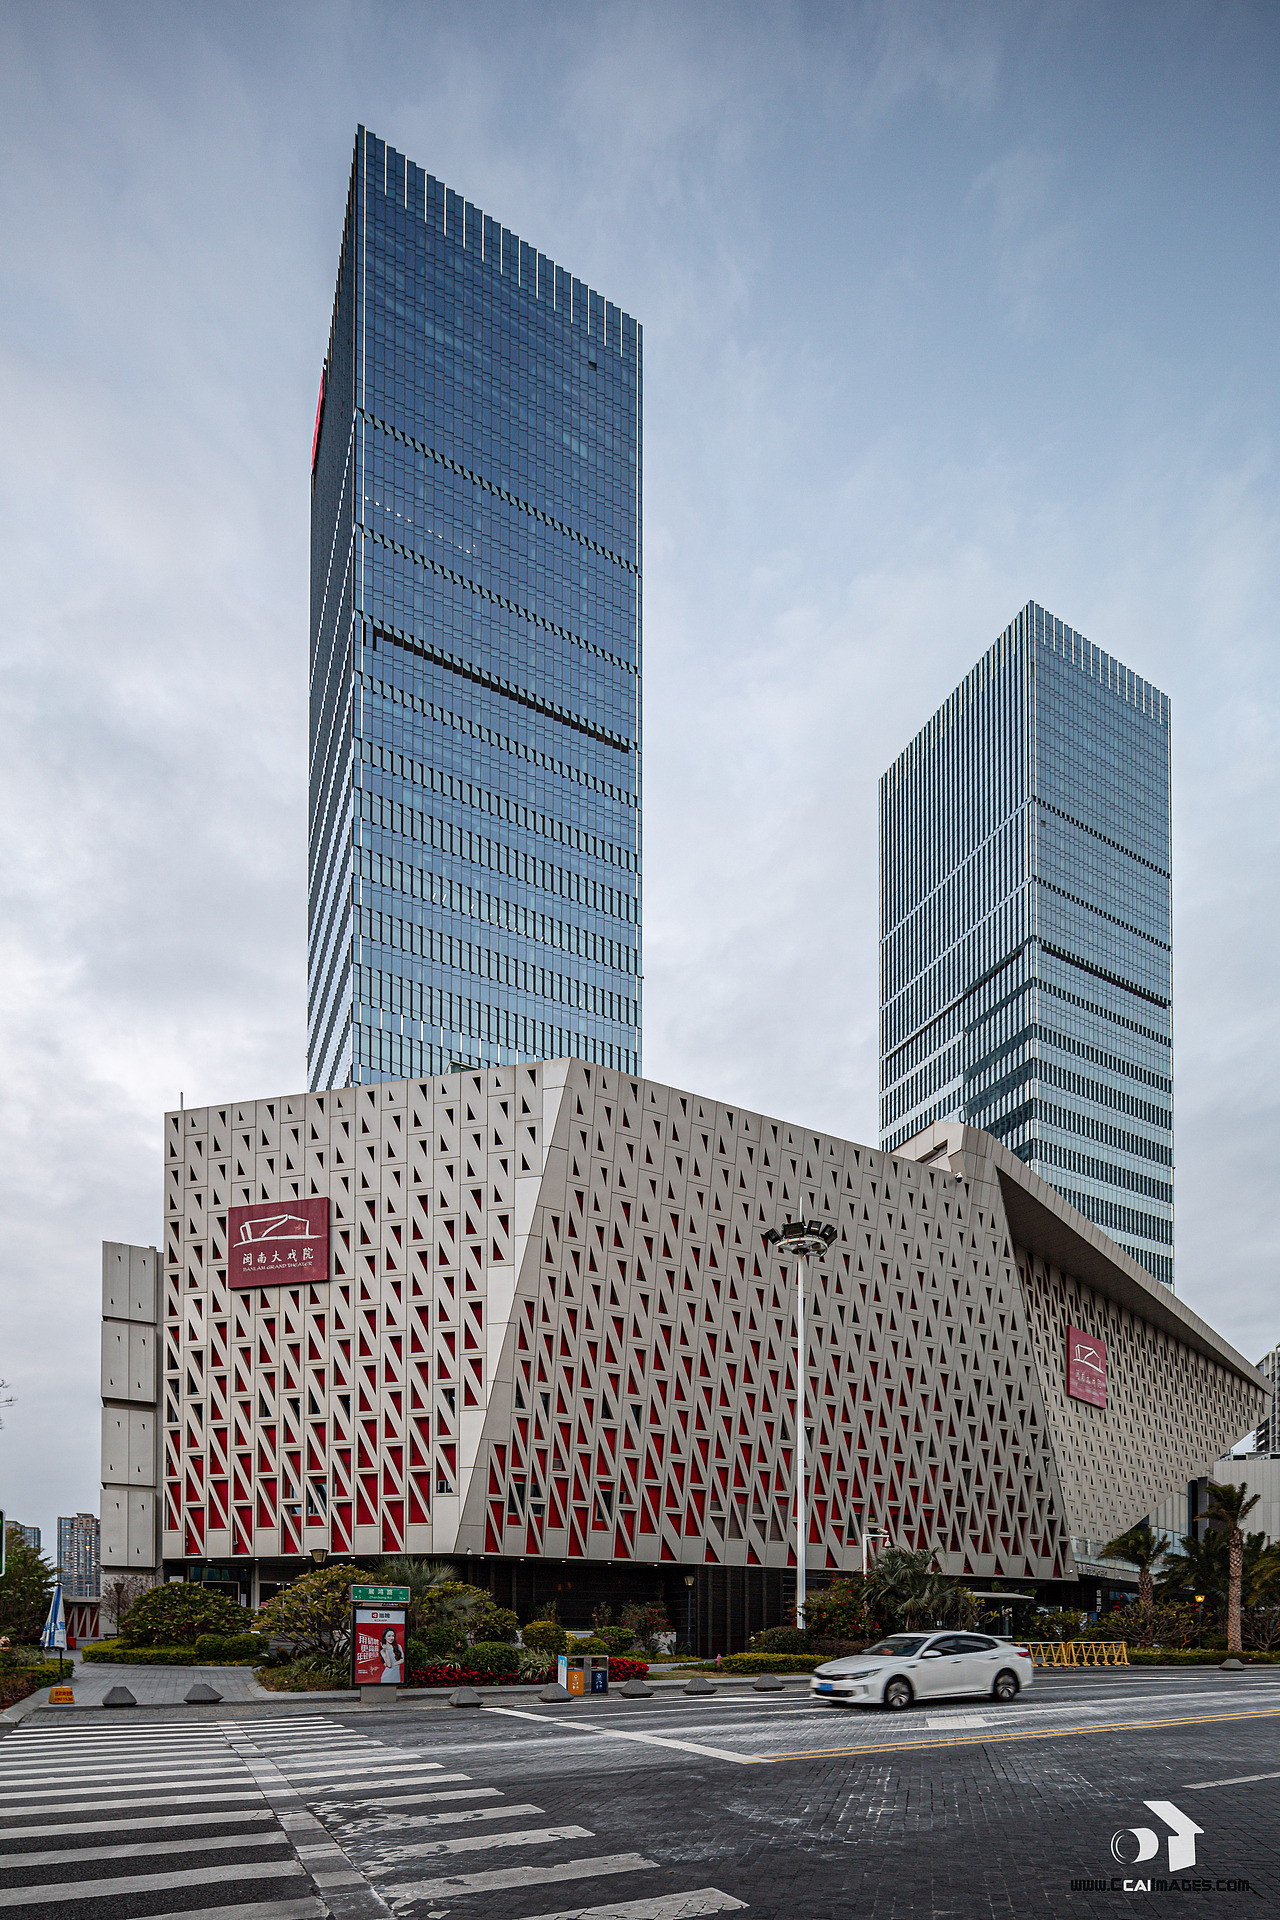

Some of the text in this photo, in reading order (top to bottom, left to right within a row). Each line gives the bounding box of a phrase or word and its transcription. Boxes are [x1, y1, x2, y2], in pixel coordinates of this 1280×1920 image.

[242, 1247, 314, 1265] 闽南大戏院
